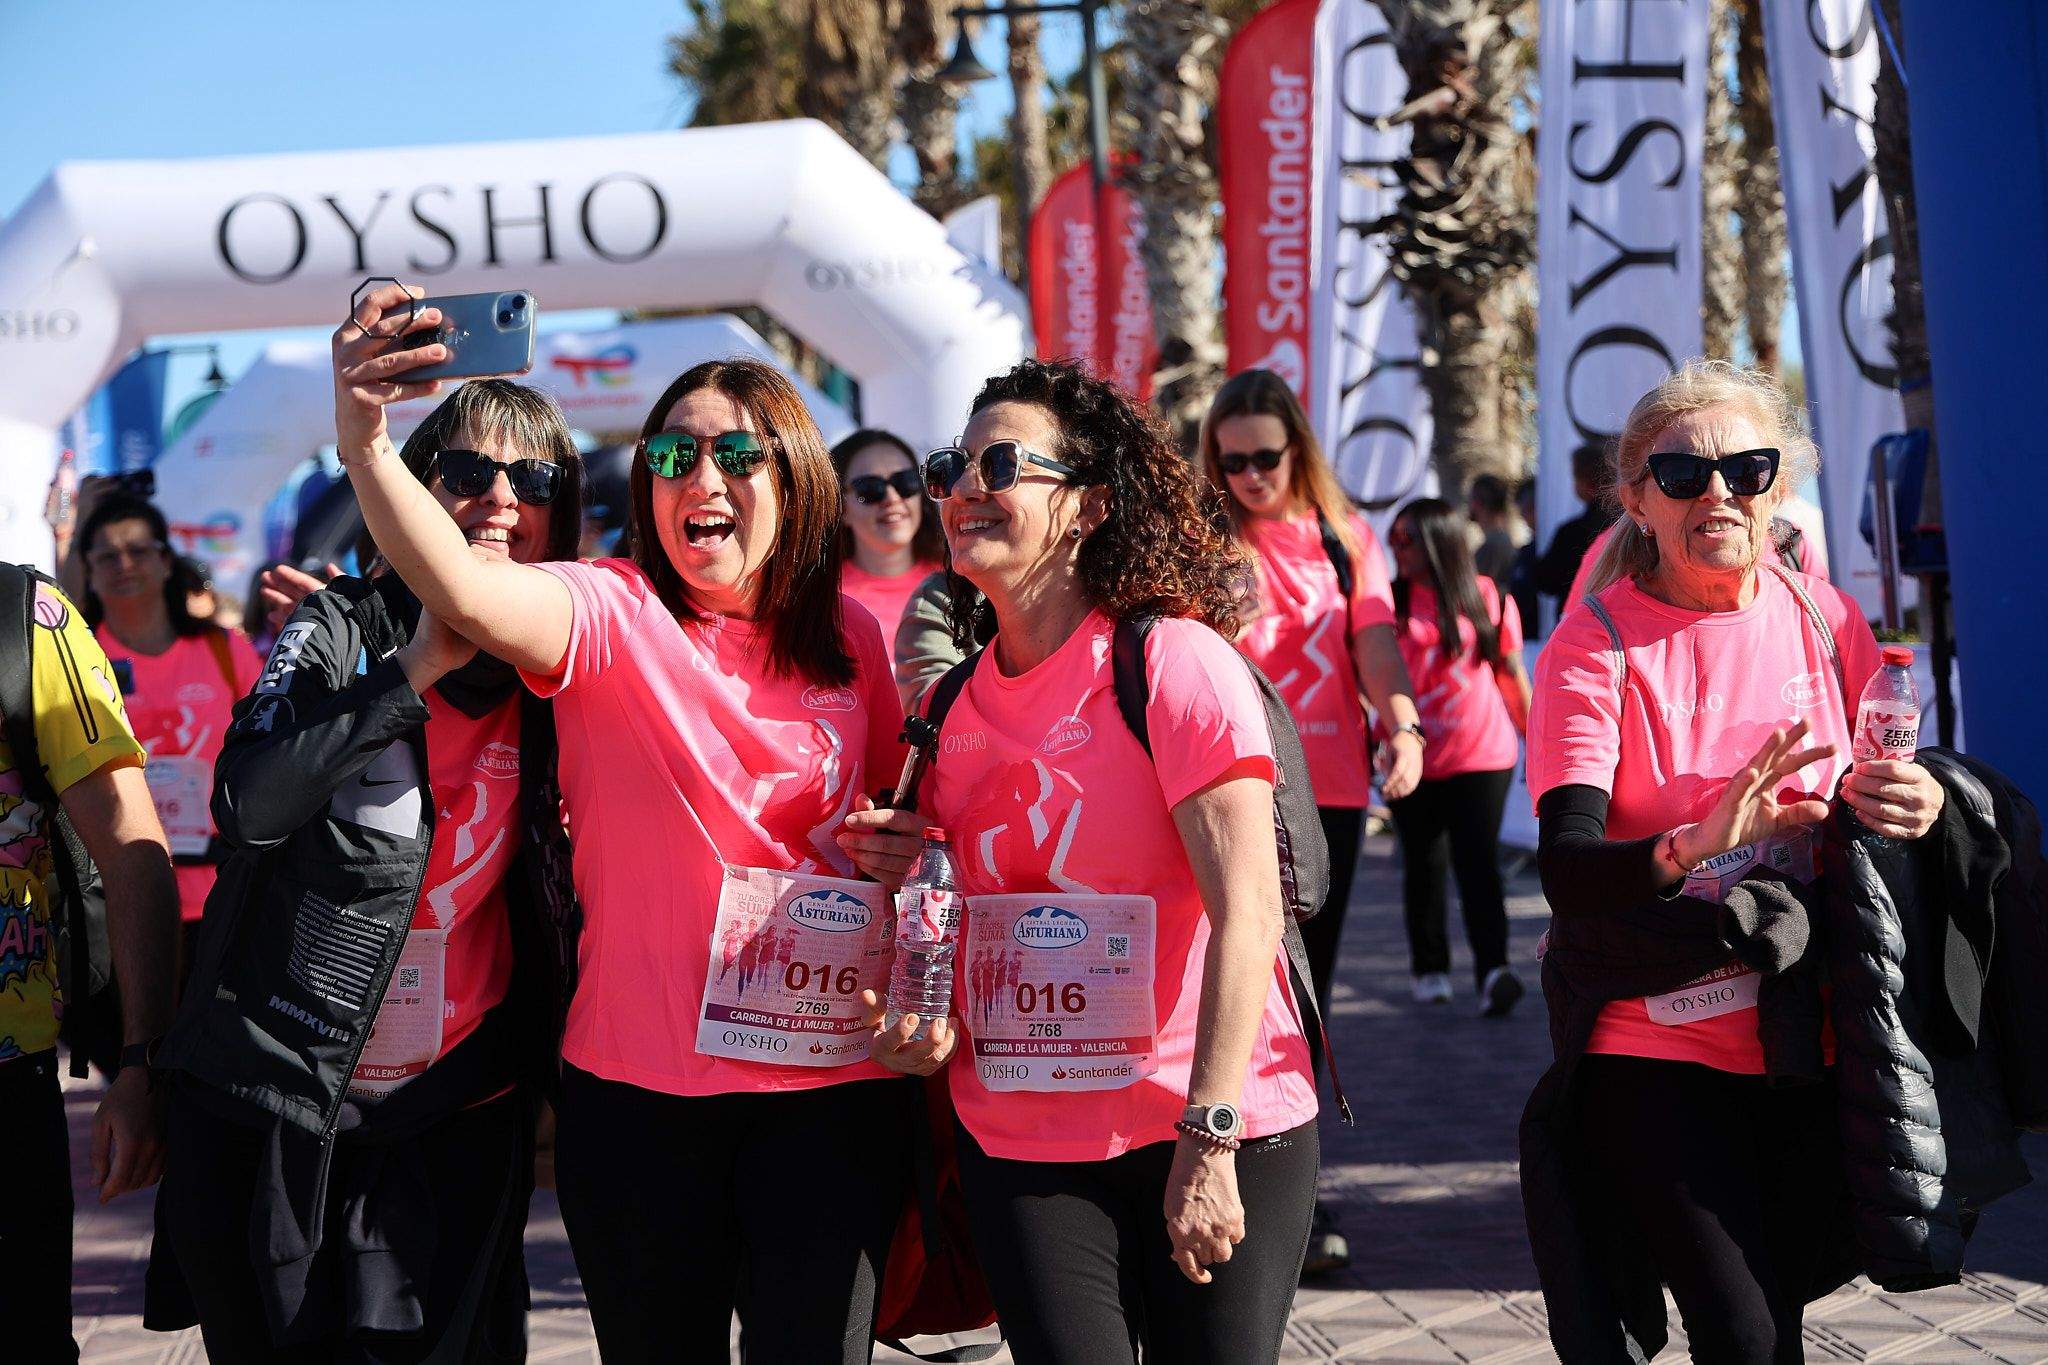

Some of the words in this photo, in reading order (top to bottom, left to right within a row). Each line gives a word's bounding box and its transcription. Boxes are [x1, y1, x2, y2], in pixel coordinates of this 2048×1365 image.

[1257, 65, 1308, 333] Santander
[217, 173, 670, 285] OYSHO
[1884, 728, 1916, 739] ZERO
[944, 731, 987, 753] OYSHO
[1882, 738, 1915, 748] SODIO
[793, 902, 866, 924] ASTURIANA
[978, 930, 1005, 942] SUMA
[1018, 922, 1082, 938] ASTURIANA
[784, 961, 859, 994] 016
[1714, 967, 1726, 978] DE
[1728, 964, 1740, 975] LA
[1016, 982, 1087, 1014] 016
[1672, 987, 1735, 1013] OYSHO
[795, 1001, 829, 1015] 2769
[268, 995, 350, 1043] MMXVIII
[730, 1010, 773, 1025] CARRERA
[776, 1017, 789, 1027] DE
[791, 1018, 802, 1028] LA
[803, 1020, 834, 1031] MUJER
[1028, 1024, 1062, 1037] 2768
[722, 1030, 788, 1052] OYSHO
[825, 1040, 867, 1055] Santander
[983, 1042, 1013, 1053] CARRERA
[1015, 1042, 1026, 1053] DE
[1028, 1042, 1040, 1053] LA
[1041, 1042, 1072, 1053] MUJER
[1081, 1041, 1127, 1053] VALENCIA
[364, 1067, 407, 1078] VALENCIA
[982, 1064, 1029, 1080] OYSHO
[1068, 1065, 1133, 1080] Santander
